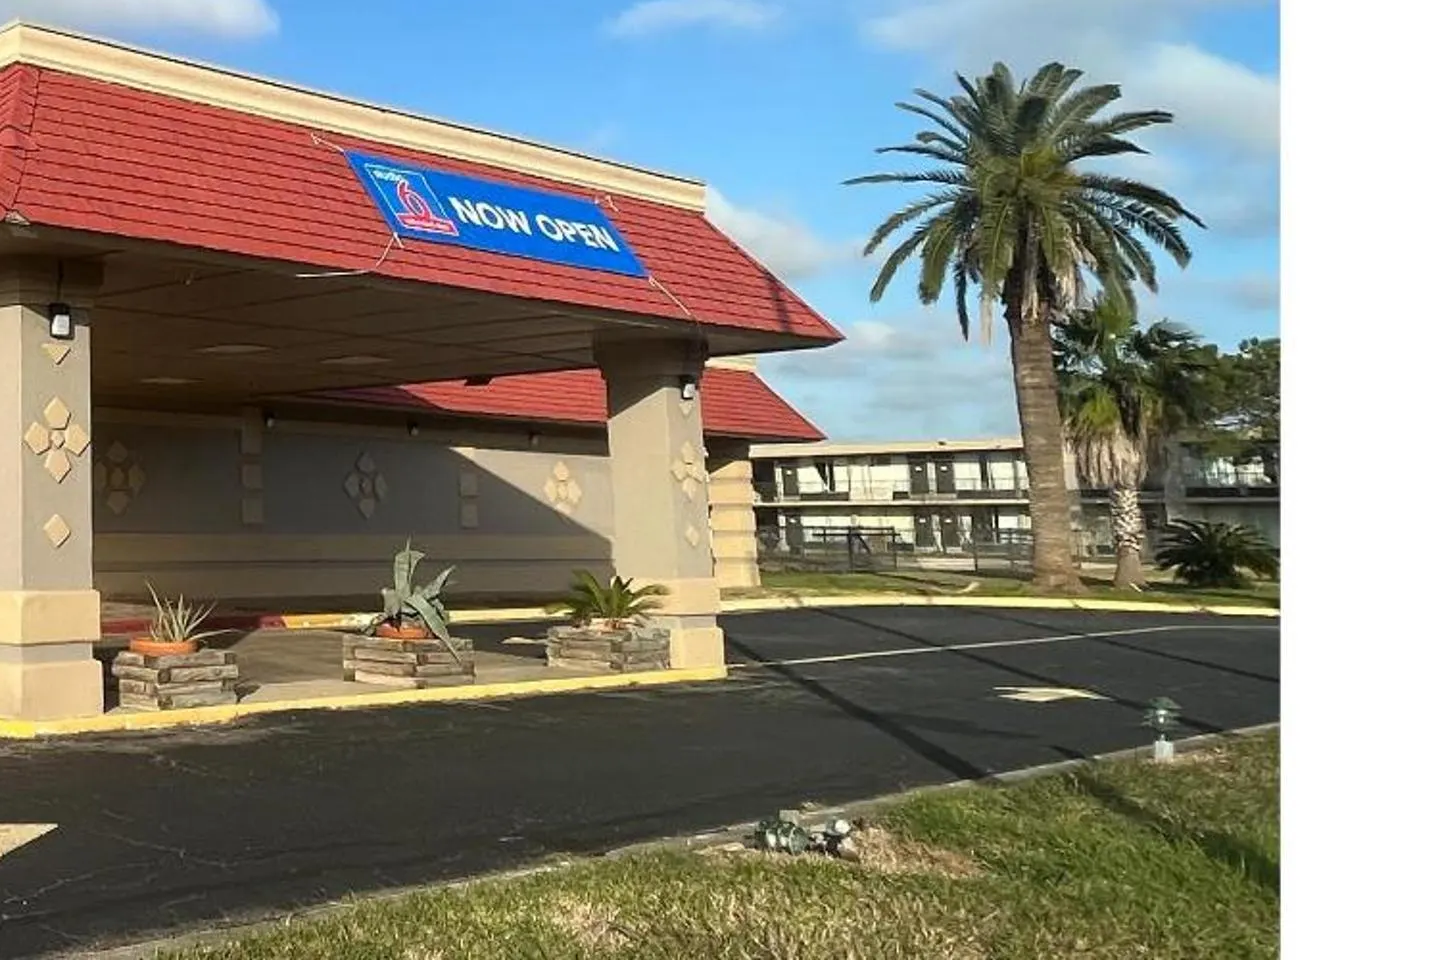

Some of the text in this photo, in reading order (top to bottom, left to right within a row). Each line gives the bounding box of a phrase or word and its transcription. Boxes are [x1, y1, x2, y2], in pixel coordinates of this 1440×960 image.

[396, 179, 434, 222] 6
[448, 196, 620, 253] NOW OPEN
